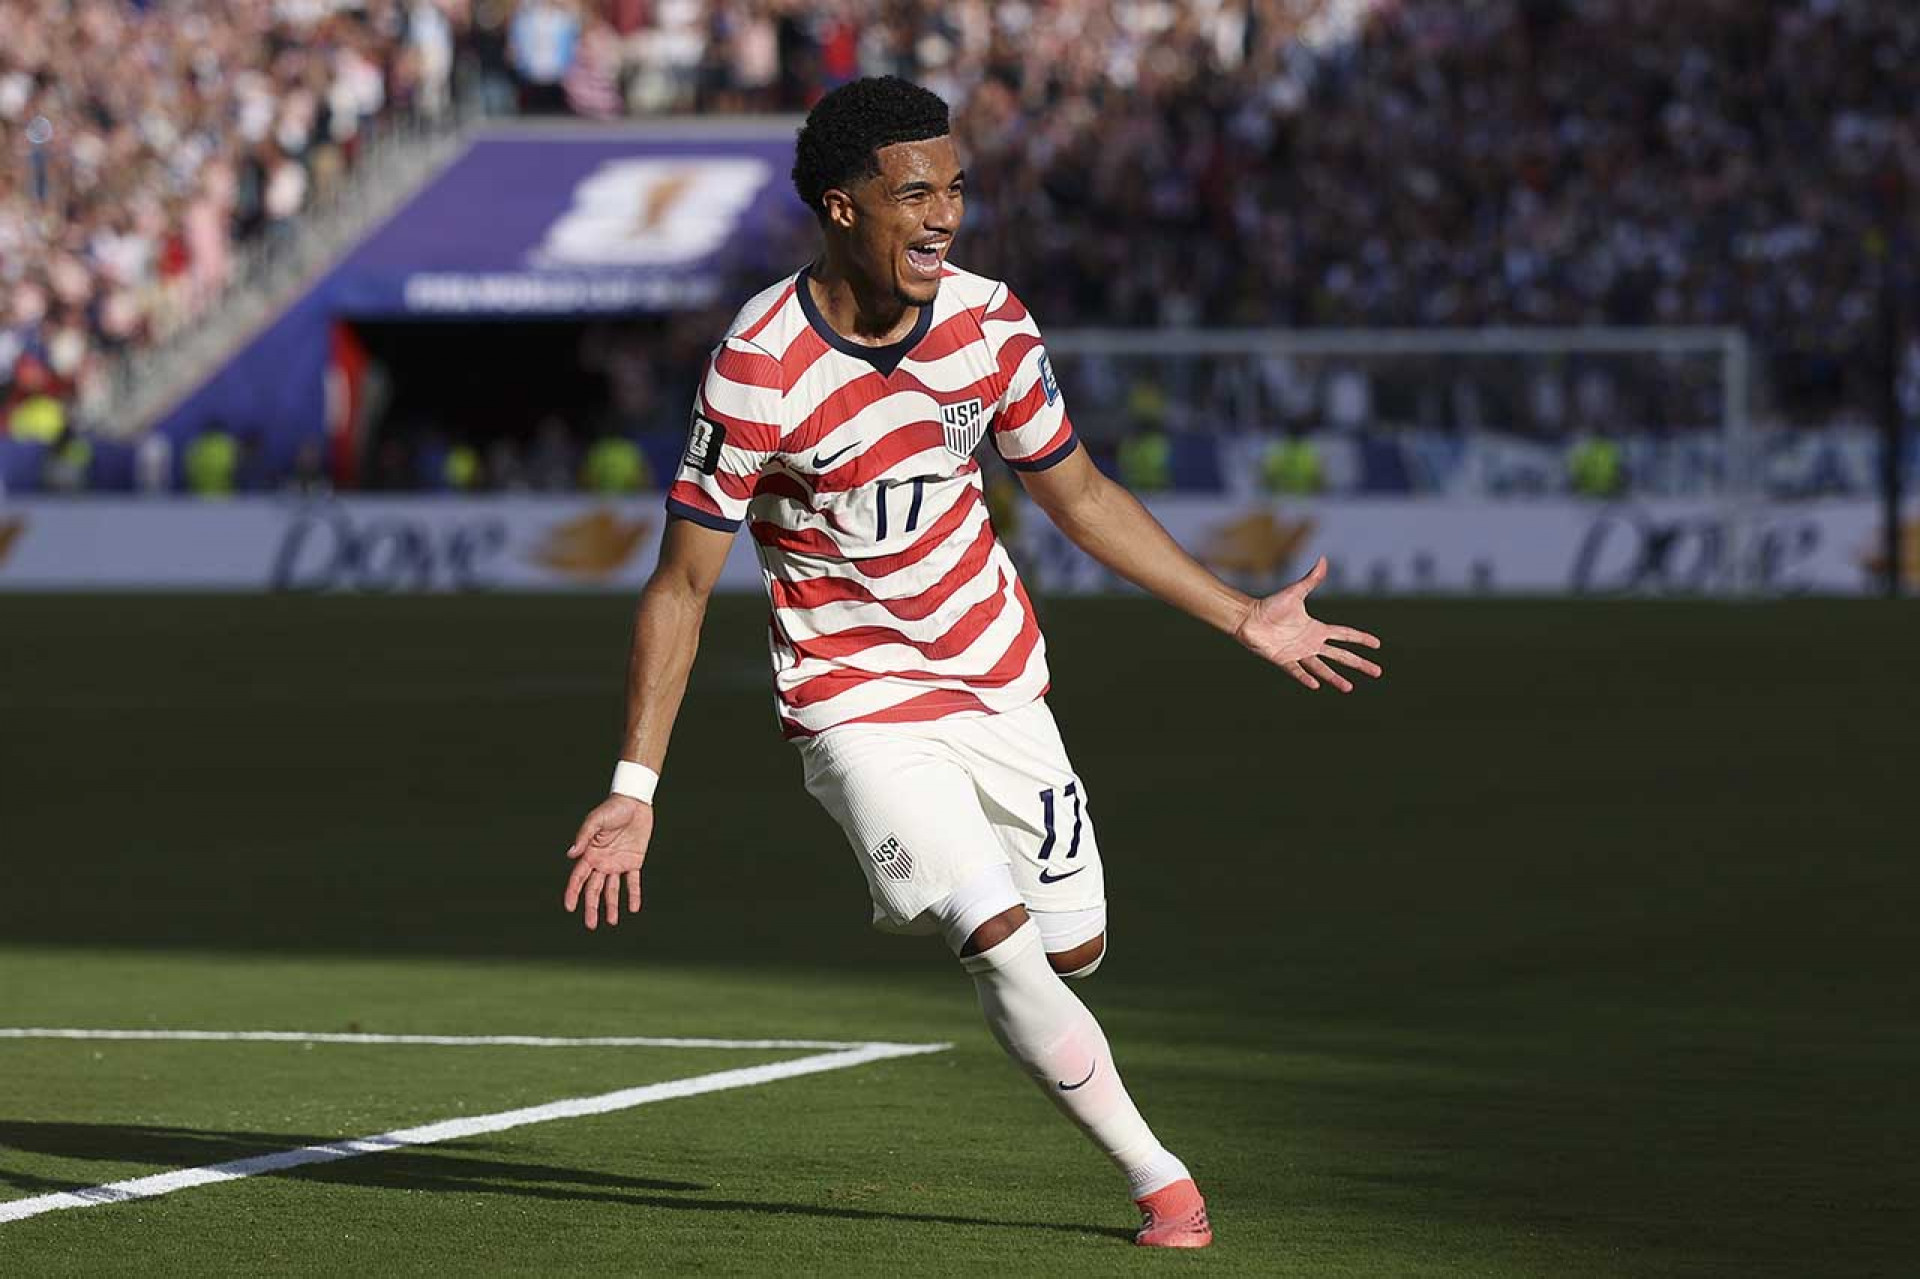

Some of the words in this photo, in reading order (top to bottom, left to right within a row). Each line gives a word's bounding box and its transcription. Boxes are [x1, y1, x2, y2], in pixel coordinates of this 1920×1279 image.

[944, 401, 979, 426] USA
[874, 478, 924, 542] 17
[268, 499, 508, 593] Dove
[872, 837, 900, 863] USA
[1037, 781, 1082, 860] 17
